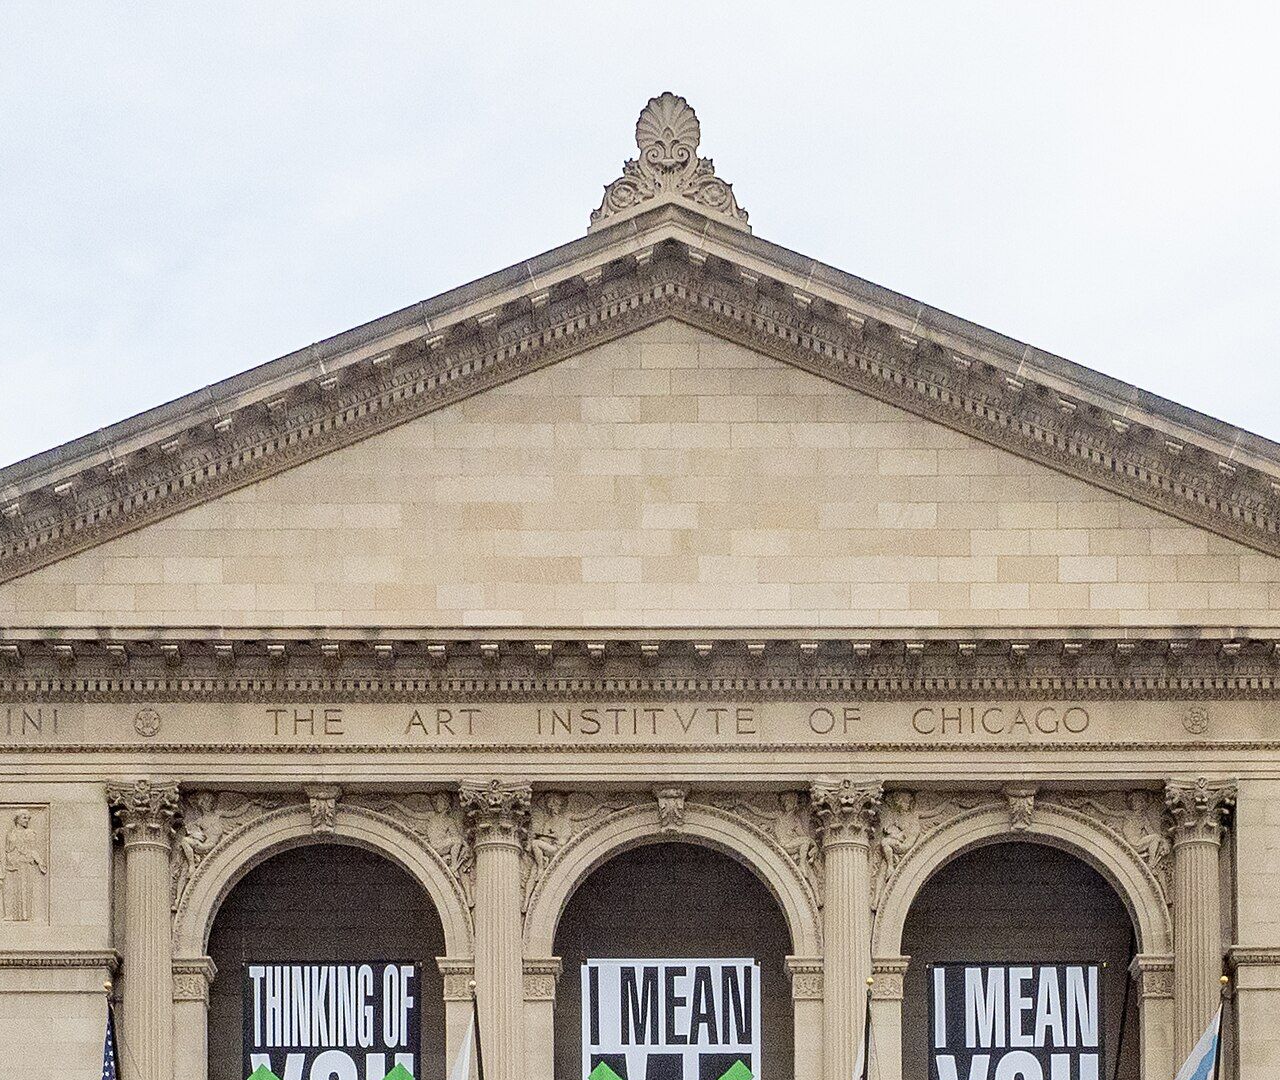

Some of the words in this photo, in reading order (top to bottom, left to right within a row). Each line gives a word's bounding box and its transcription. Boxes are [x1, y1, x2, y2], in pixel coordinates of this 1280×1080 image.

[265, 708, 345, 736] THE
[404, 708, 482, 736] ART
[536, 708, 757, 736] INSTITVTE
[808, 706, 862, 735] OF
[912, 706, 1090, 735] CHICAGO
[249, 964, 374, 1049] THINKING
[382, 964, 414, 1049] OF
[589, 966, 601, 1046] I
[620, 966, 753, 1046] MEAN
[933, 967, 947, 1049] I
[965, 966, 1099, 1049] MEAN
